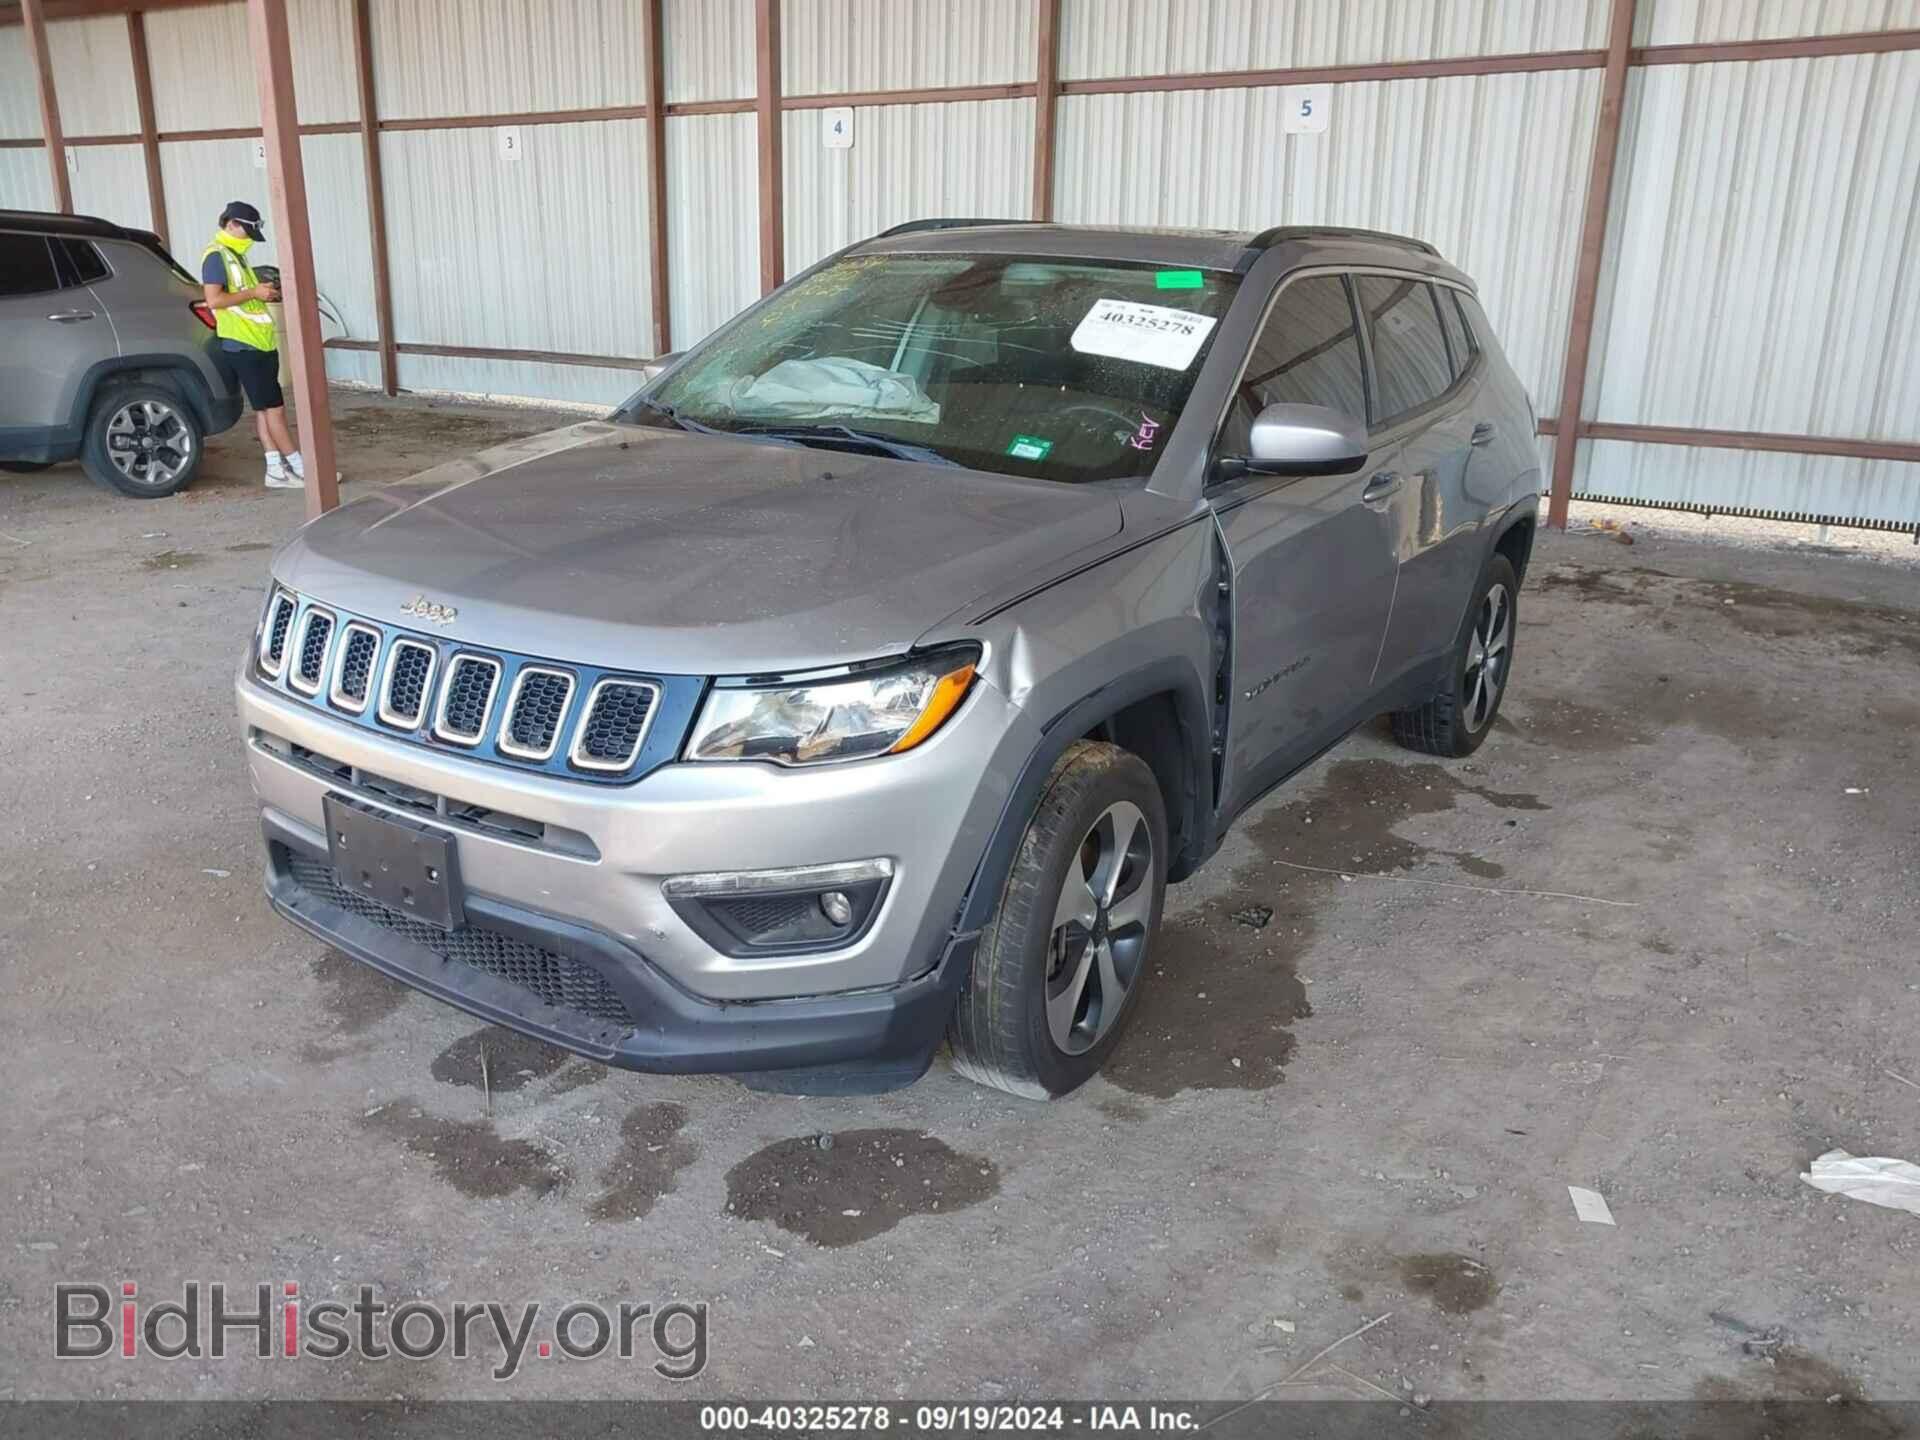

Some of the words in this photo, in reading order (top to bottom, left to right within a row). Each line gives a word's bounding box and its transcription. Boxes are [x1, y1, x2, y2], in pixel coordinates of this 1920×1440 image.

[1301, 99, 1313, 117] 5
[833, 119, 843, 135] 4
[506, 136, 514, 149] 3
[1100, 311, 1196, 336] 40325278
[400, 595, 458, 624] Jeep
